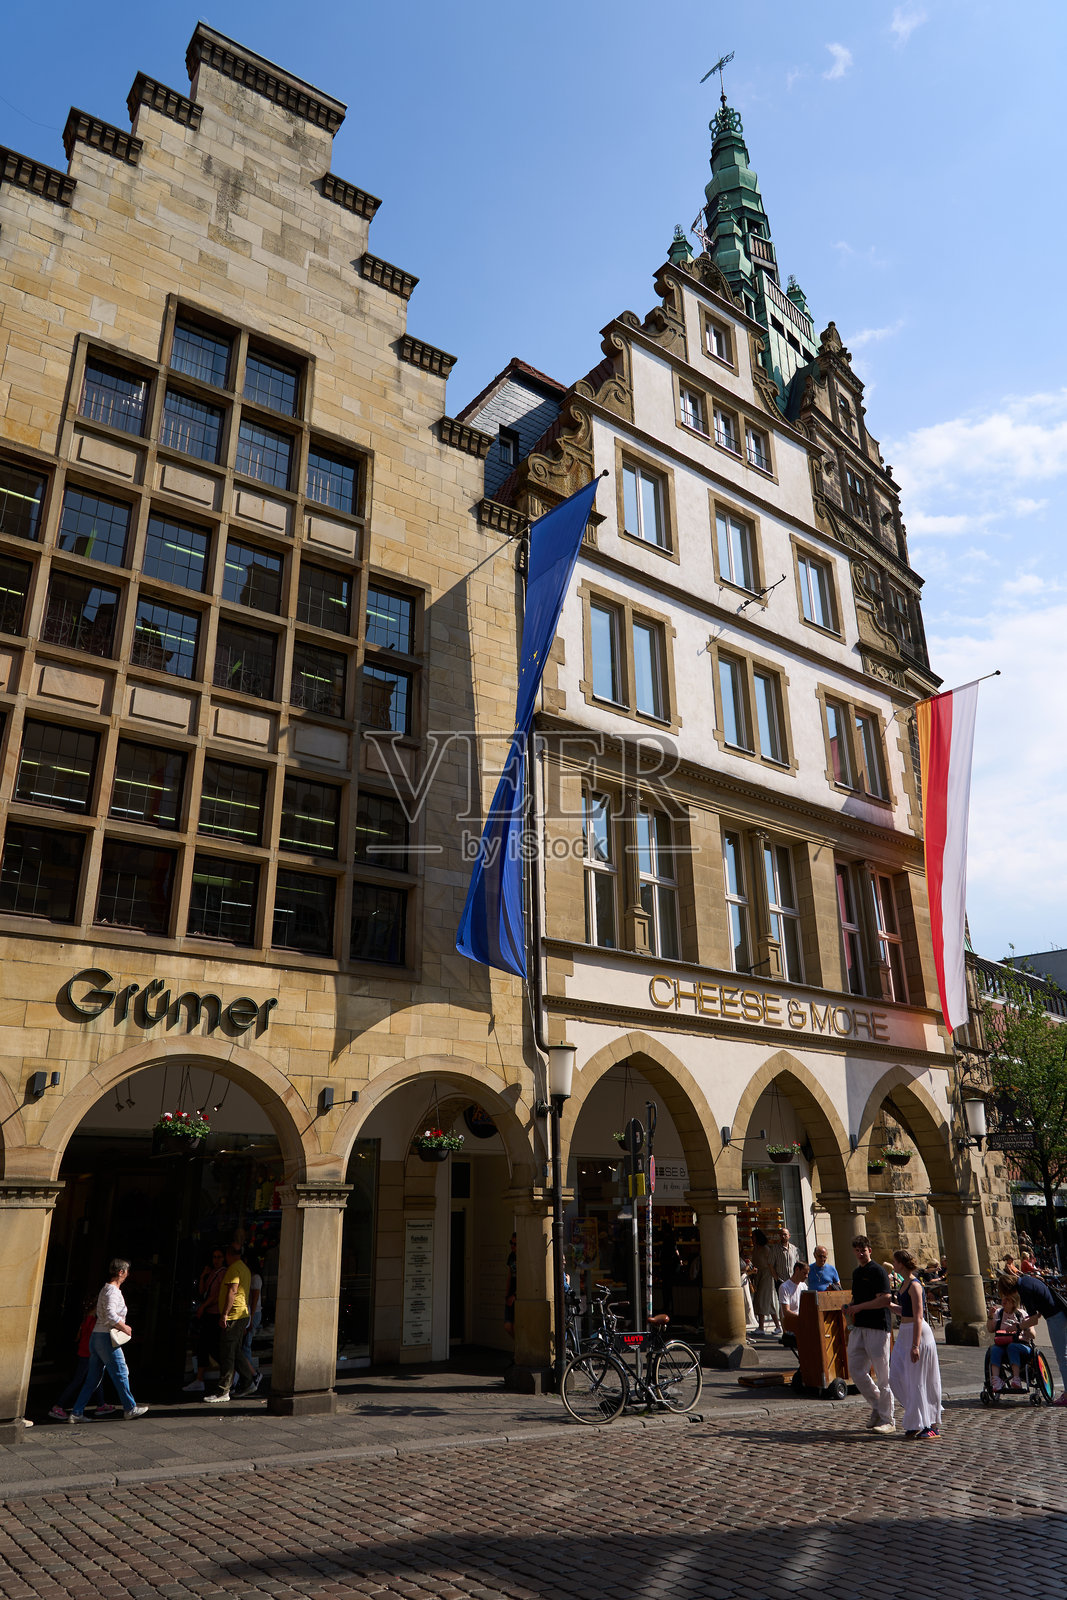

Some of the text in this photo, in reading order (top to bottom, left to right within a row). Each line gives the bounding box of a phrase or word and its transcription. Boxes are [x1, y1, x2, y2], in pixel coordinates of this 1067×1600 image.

[66, 968, 278, 1031] Grümer
[651, 975, 891, 1041] CHEESE & MORE
[623, 1335, 644, 1343] LLOYD
